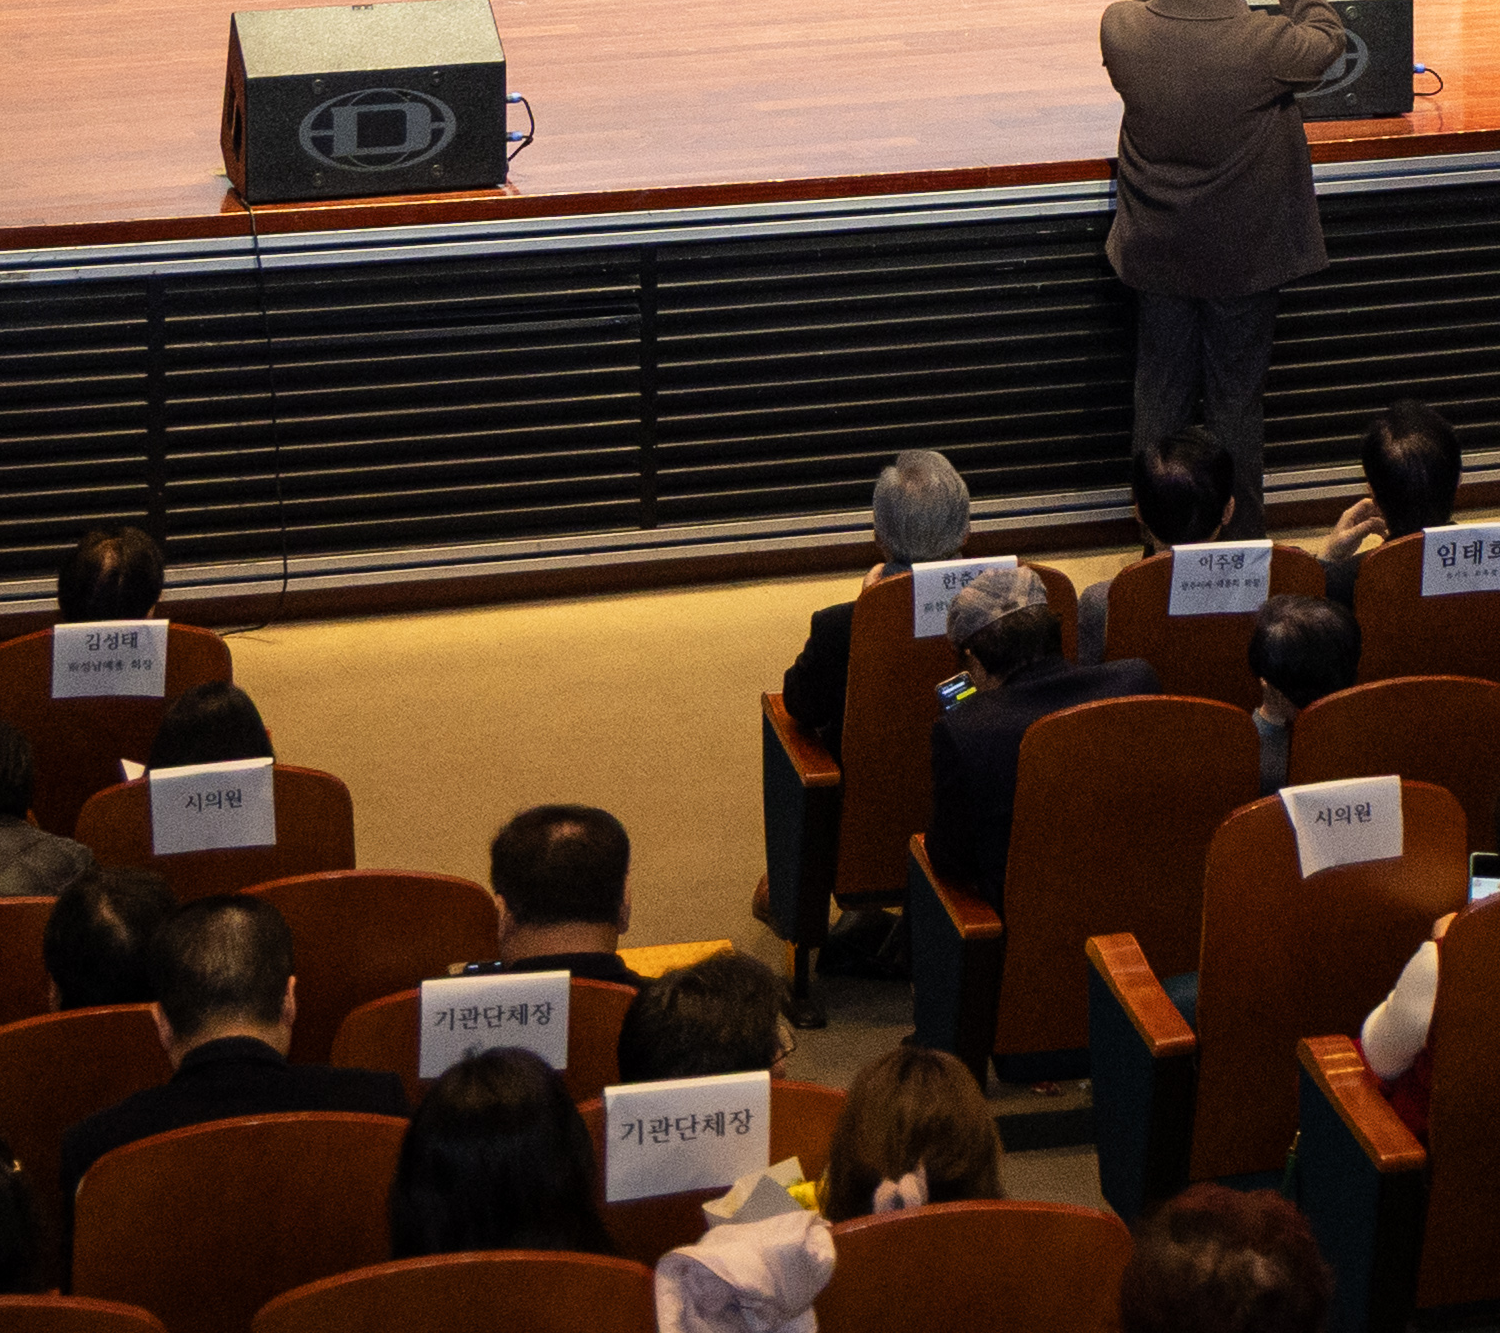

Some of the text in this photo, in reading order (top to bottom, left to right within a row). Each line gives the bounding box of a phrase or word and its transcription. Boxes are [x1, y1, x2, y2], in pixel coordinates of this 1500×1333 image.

[1198, 552, 1245, 572] 이주영
[942, 570, 984, 590] 한춘
[85, 631, 138, 651] 김성태
[185, 788, 243, 813] 시의원
[1315, 801, 1373, 827] 시의원
[434, 1001, 555, 1032] 기관단체장
[621, 1108, 755, 1145] 기관단체장
